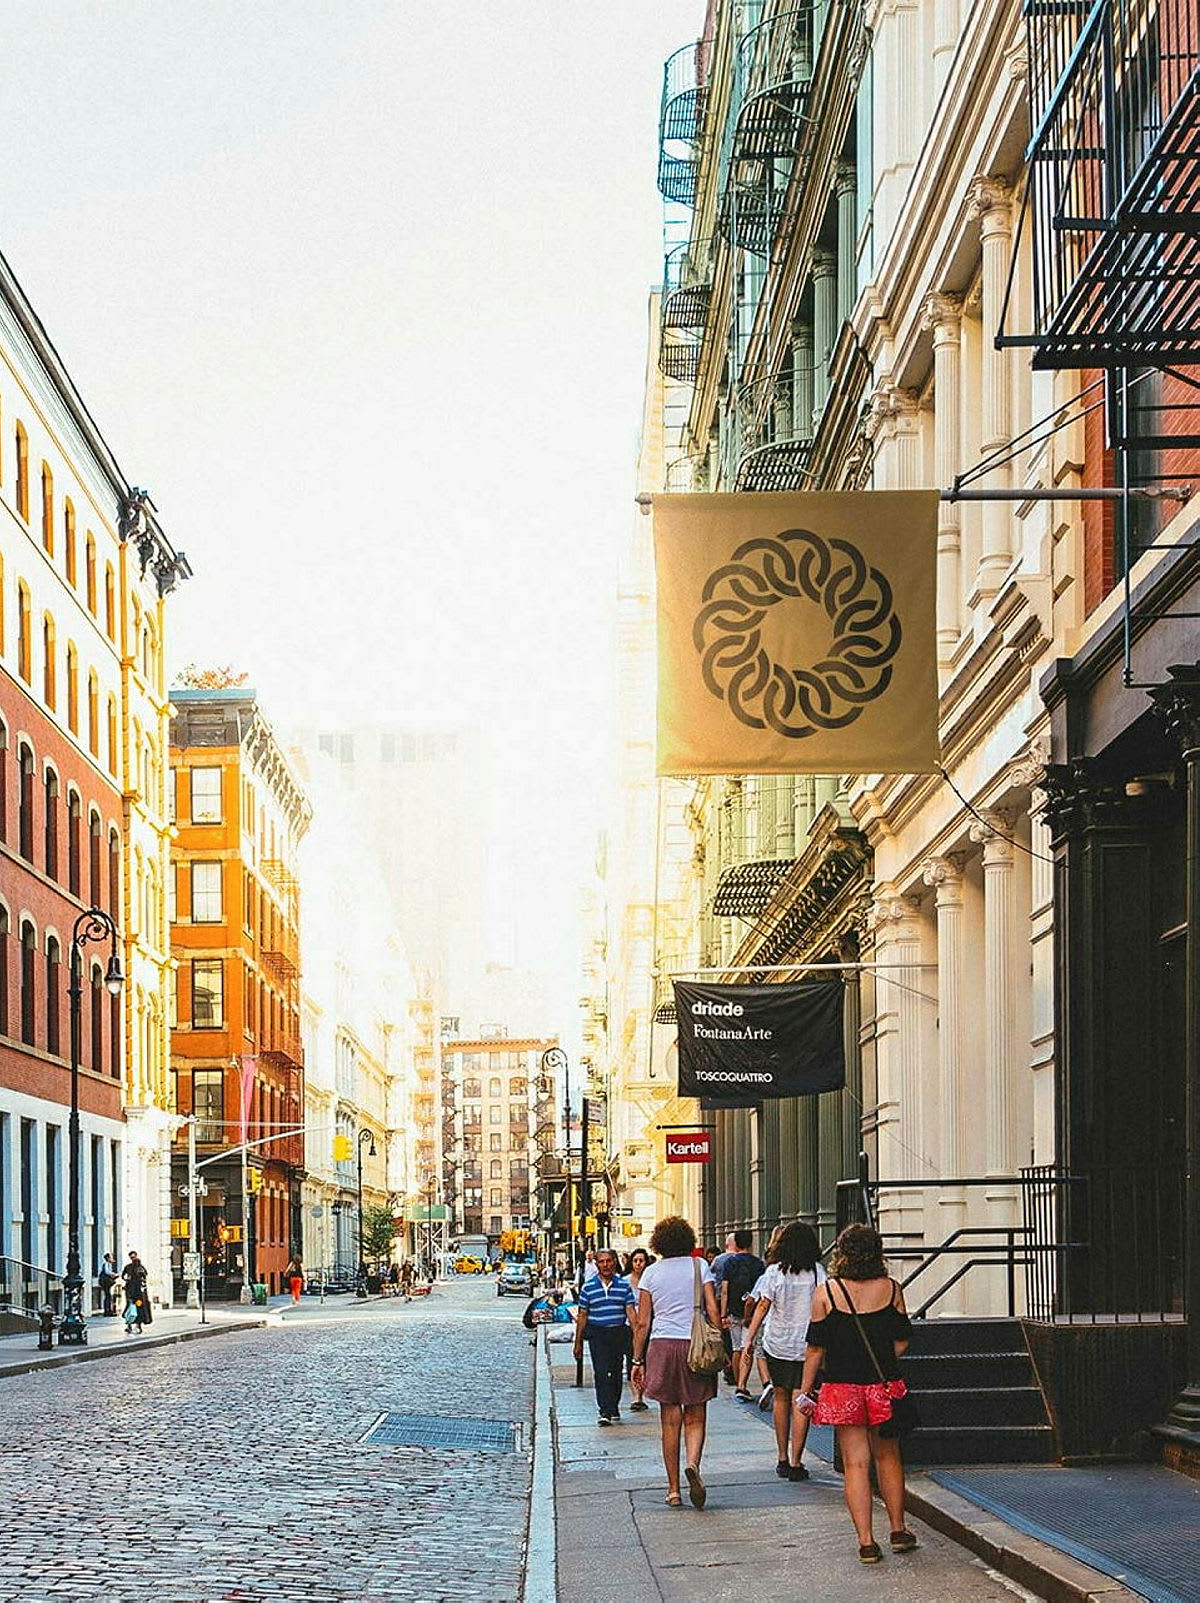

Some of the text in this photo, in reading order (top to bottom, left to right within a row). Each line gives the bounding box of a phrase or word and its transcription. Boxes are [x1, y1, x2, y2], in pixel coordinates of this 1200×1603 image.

[691, 1001, 744, 1016] driade
[694, 1024, 773, 1040] FontanaArte
[695, 1071, 773, 1083] TOSCOQUATTRO
[667, 1141, 709, 1155] Kartell
